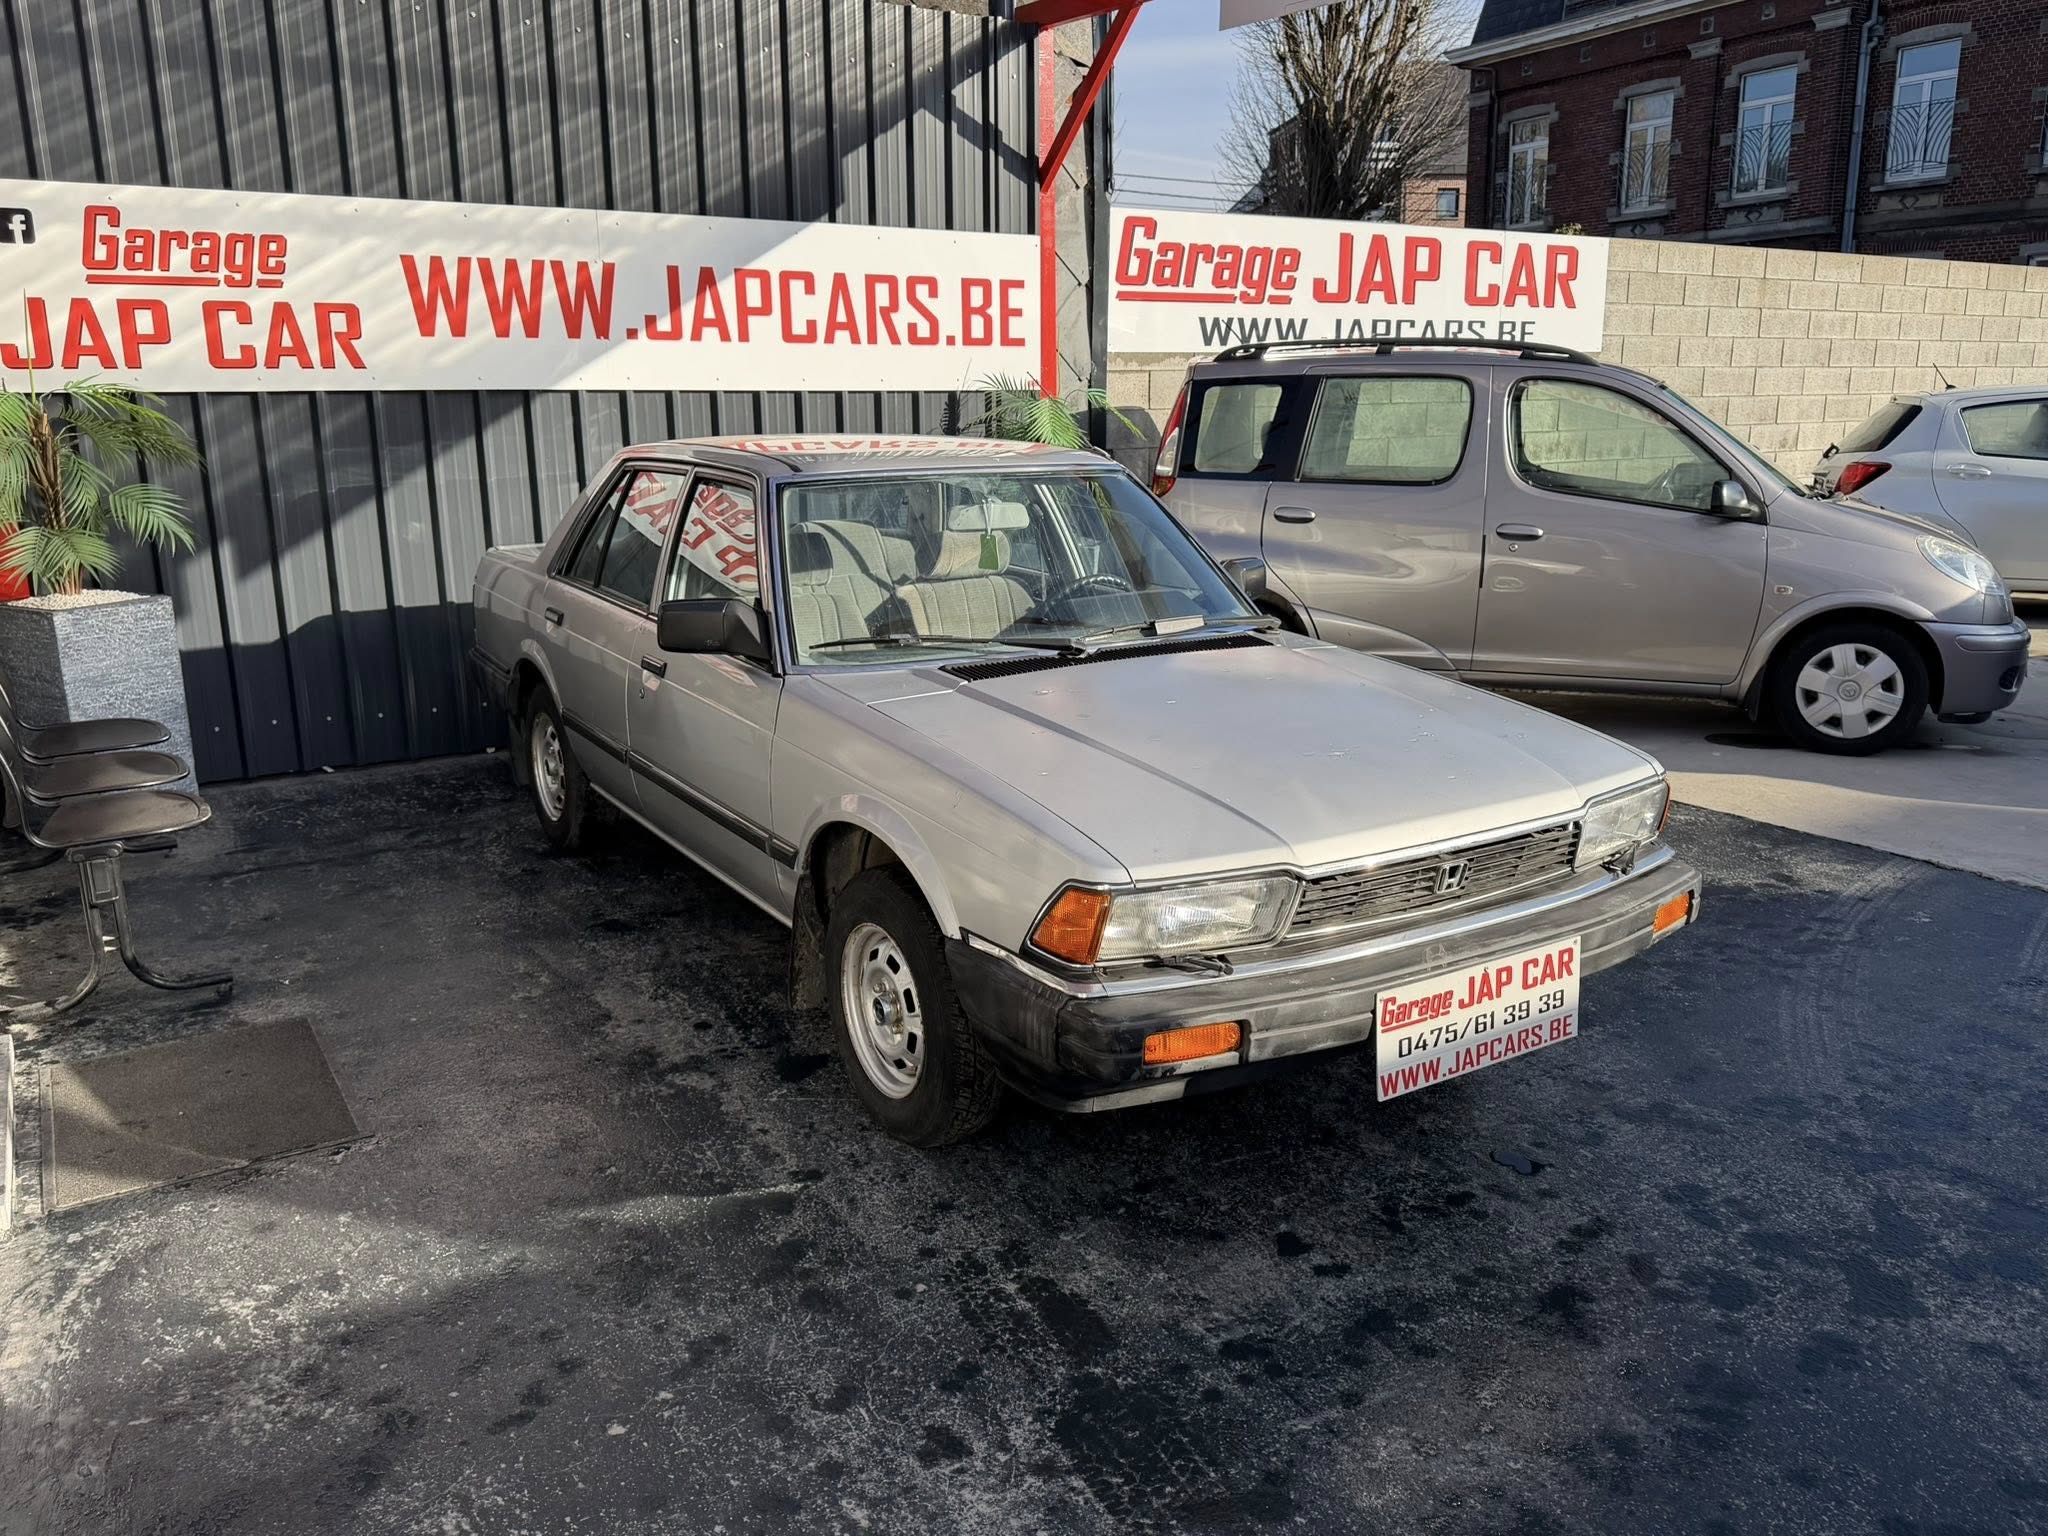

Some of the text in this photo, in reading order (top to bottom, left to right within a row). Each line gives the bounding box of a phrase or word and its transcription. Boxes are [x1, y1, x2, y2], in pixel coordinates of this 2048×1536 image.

[82, 205, 287, 288] Garage
[1116, 216, 1579, 308] Garage JAP CAR
[0, 297, 366, 370] JAP CAR
[401, 255, 1026, 348] WWW.JAPCARS.BE
[1380, 947, 1575, 1028] Garage JAP CAR
[1399, 989, 1565, 1058] 0475/61 39 39
[1380, 1015, 1574, 1097] WWW.JAPCARS.BE
